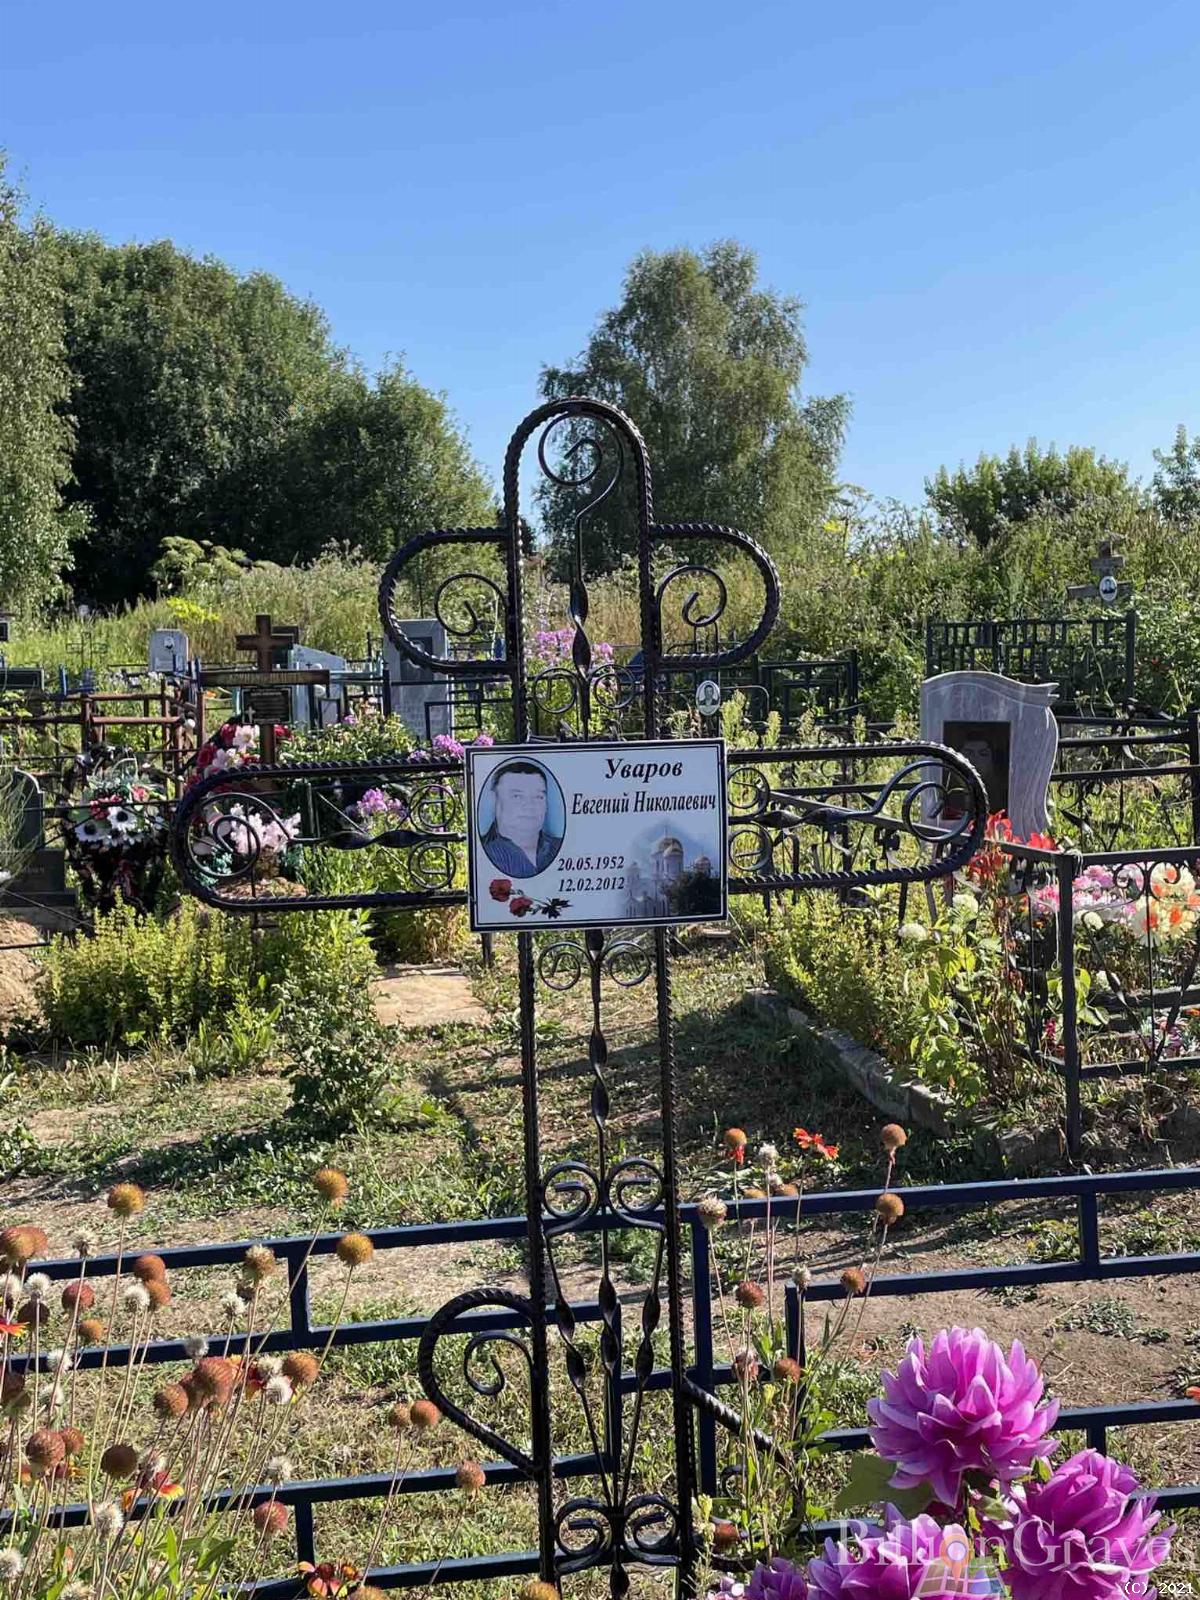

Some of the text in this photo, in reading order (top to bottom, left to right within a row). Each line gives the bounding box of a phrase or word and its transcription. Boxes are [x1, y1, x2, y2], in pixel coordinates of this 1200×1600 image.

[605, 758, 683, 783] Уваров
[571, 790, 717, 815] Евгений Николаевич
[557, 855, 625, 871] 20.05.1952
[558, 876, 625, 892] 12.02.2012
